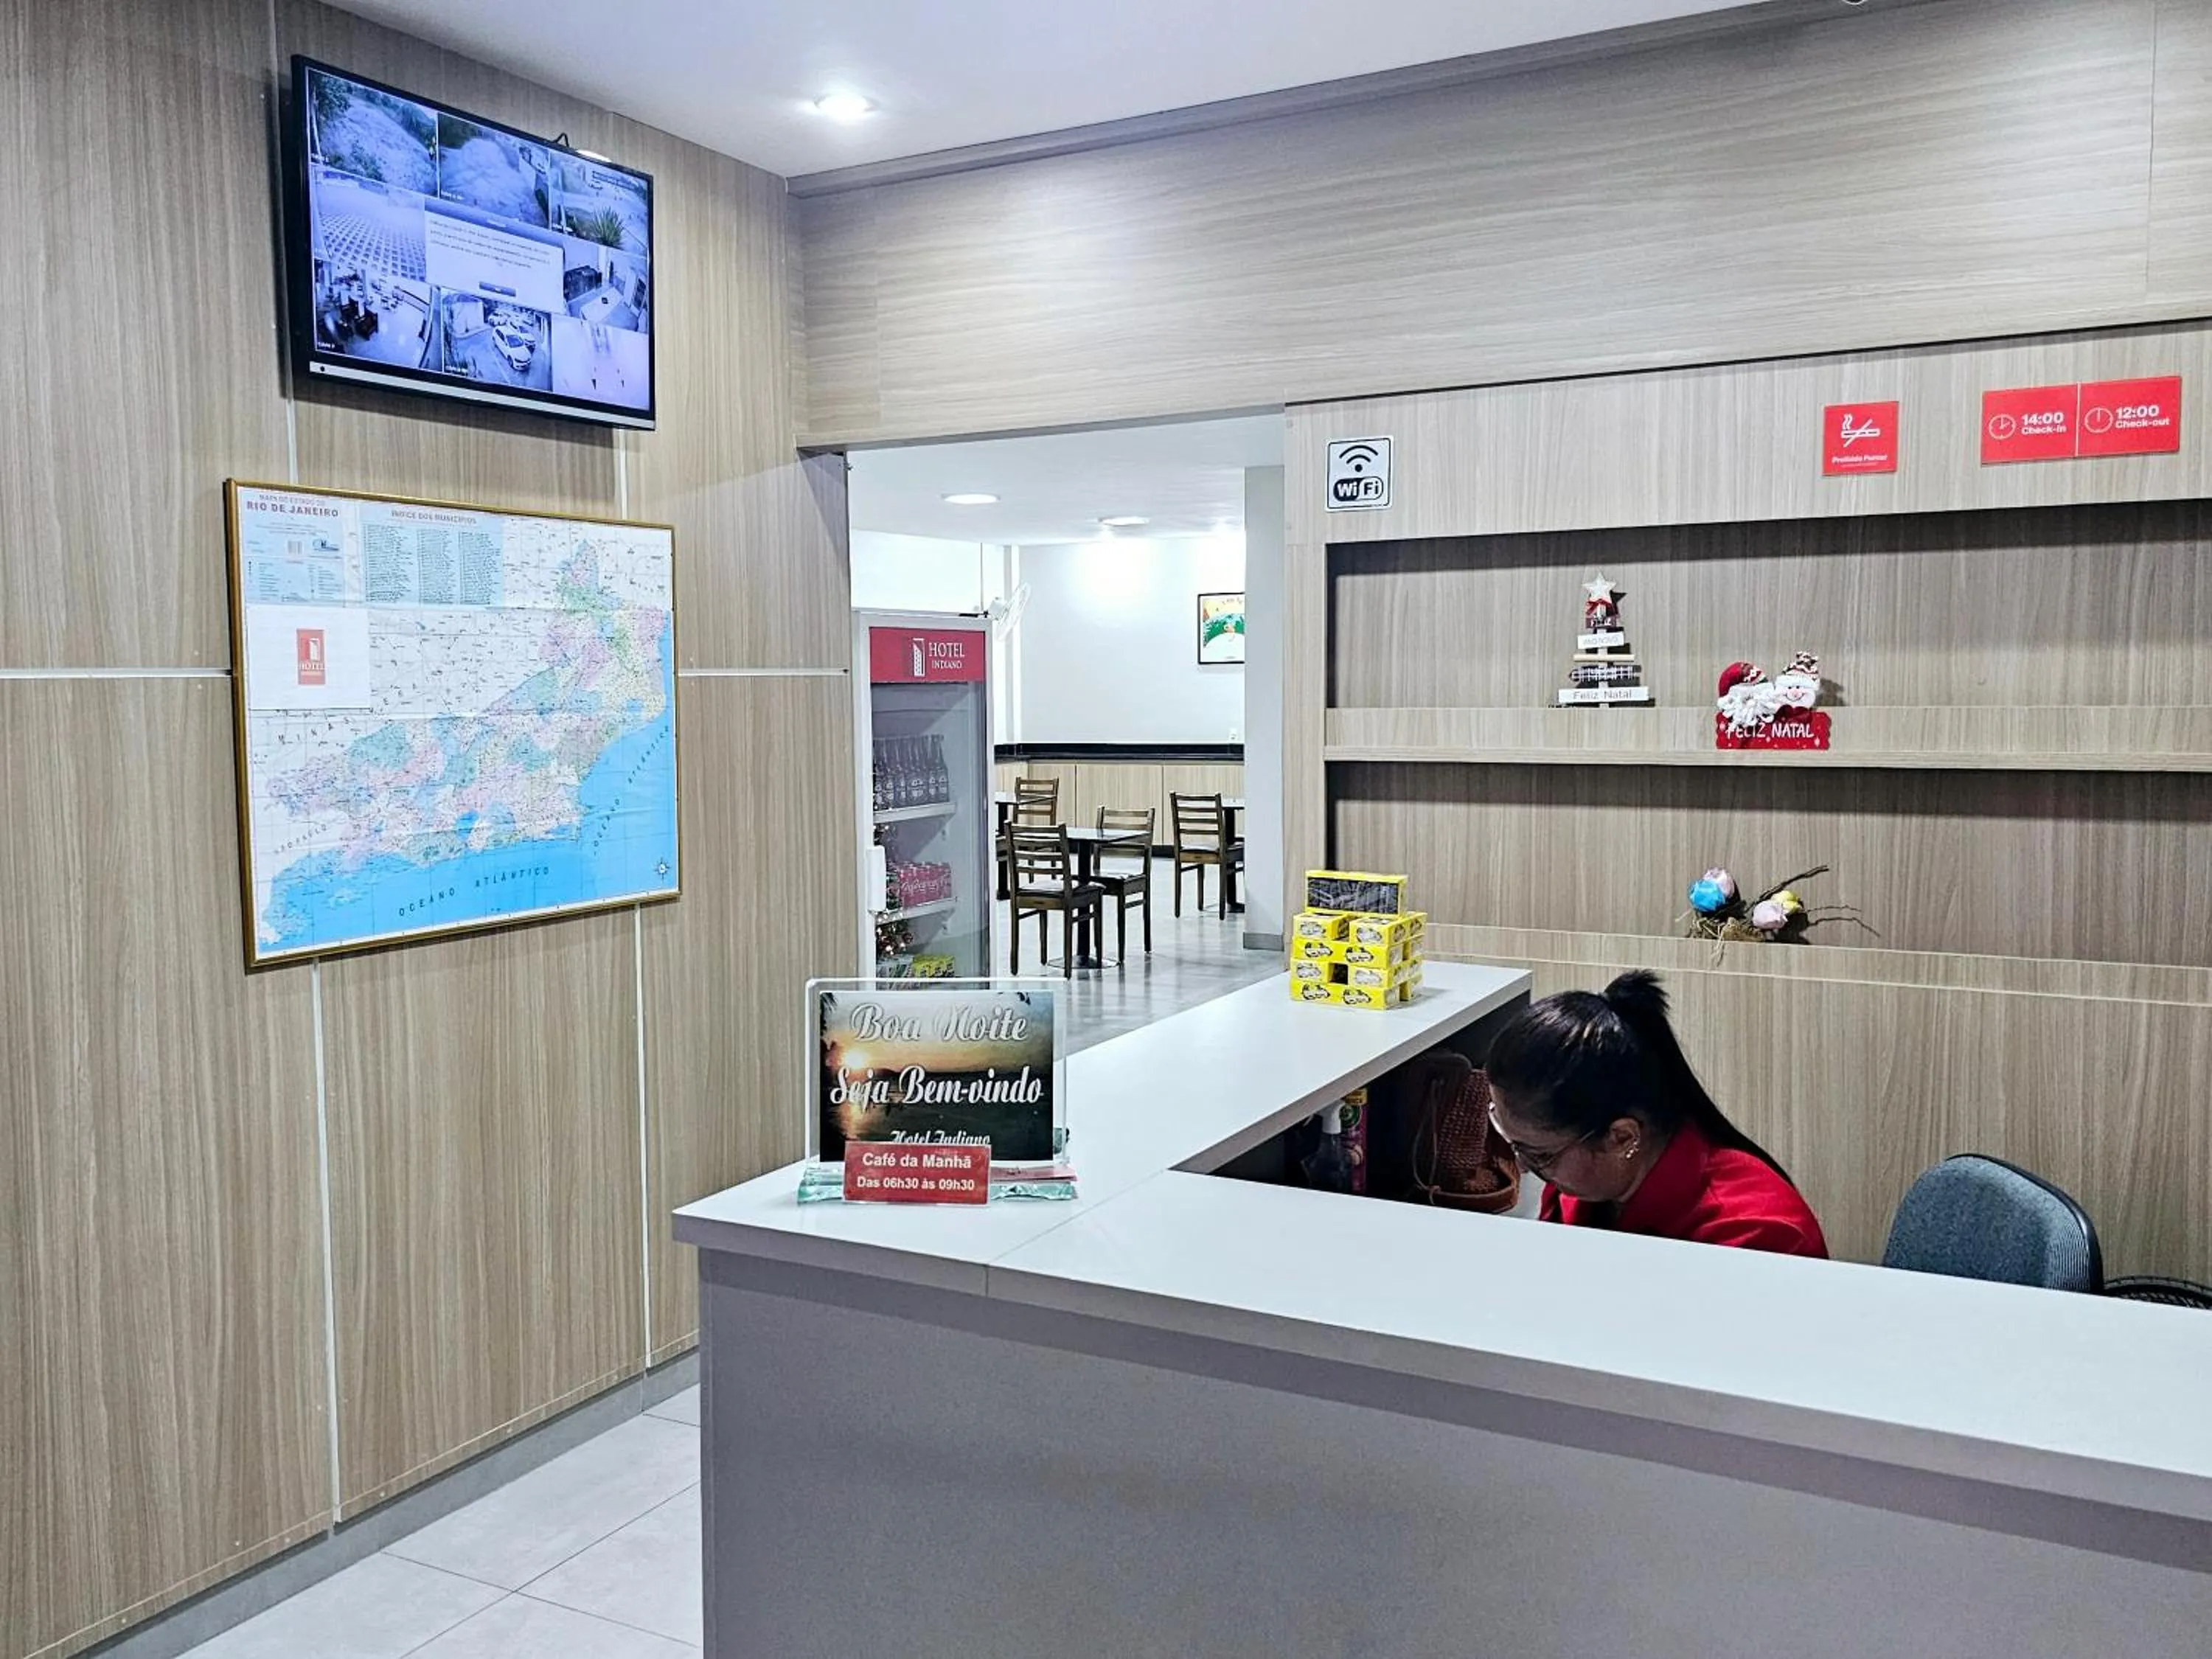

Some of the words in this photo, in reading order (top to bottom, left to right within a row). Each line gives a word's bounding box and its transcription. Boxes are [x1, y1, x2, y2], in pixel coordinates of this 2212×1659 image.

[2021, 412, 2064, 425] 14:00
[2115, 406, 2160, 420] 12:00
[2021, 425, 2067, 435] Check-in
[2115, 417, 2170, 429] Check-out
[246, 501, 267, 511] RIO
[271, 504, 285, 512] DE
[289, 504, 339, 517] JANEIRO
[928, 642, 965, 657] HOTEL
[931, 660, 962, 669] INDIANO
[1604, 689, 1632, 700] Natal
[1725, 722, 1767, 739] FELIZ
[1771, 723, 1815, 738] NATAL
[399, 887, 455, 917] OCEANO
[850, 1002, 922, 1042] Boa
[933, 1003, 1029, 1042] Noite
[830, 1066, 891, 1113] Seja
[899, 1065, 1044, 1105] Bem-vindo
[890, 1130, 931, 1144] Hotel
[862, 1152, 897, 1166] Café
[900, 1154, 918, 1167] da
[922, 1154, 972, 1169] Manhã
[857, 1176, 880, 1188] Das
[883, 1178, 919, 1189] 06h30
[939, 1179, 975, 1191] 09h30
